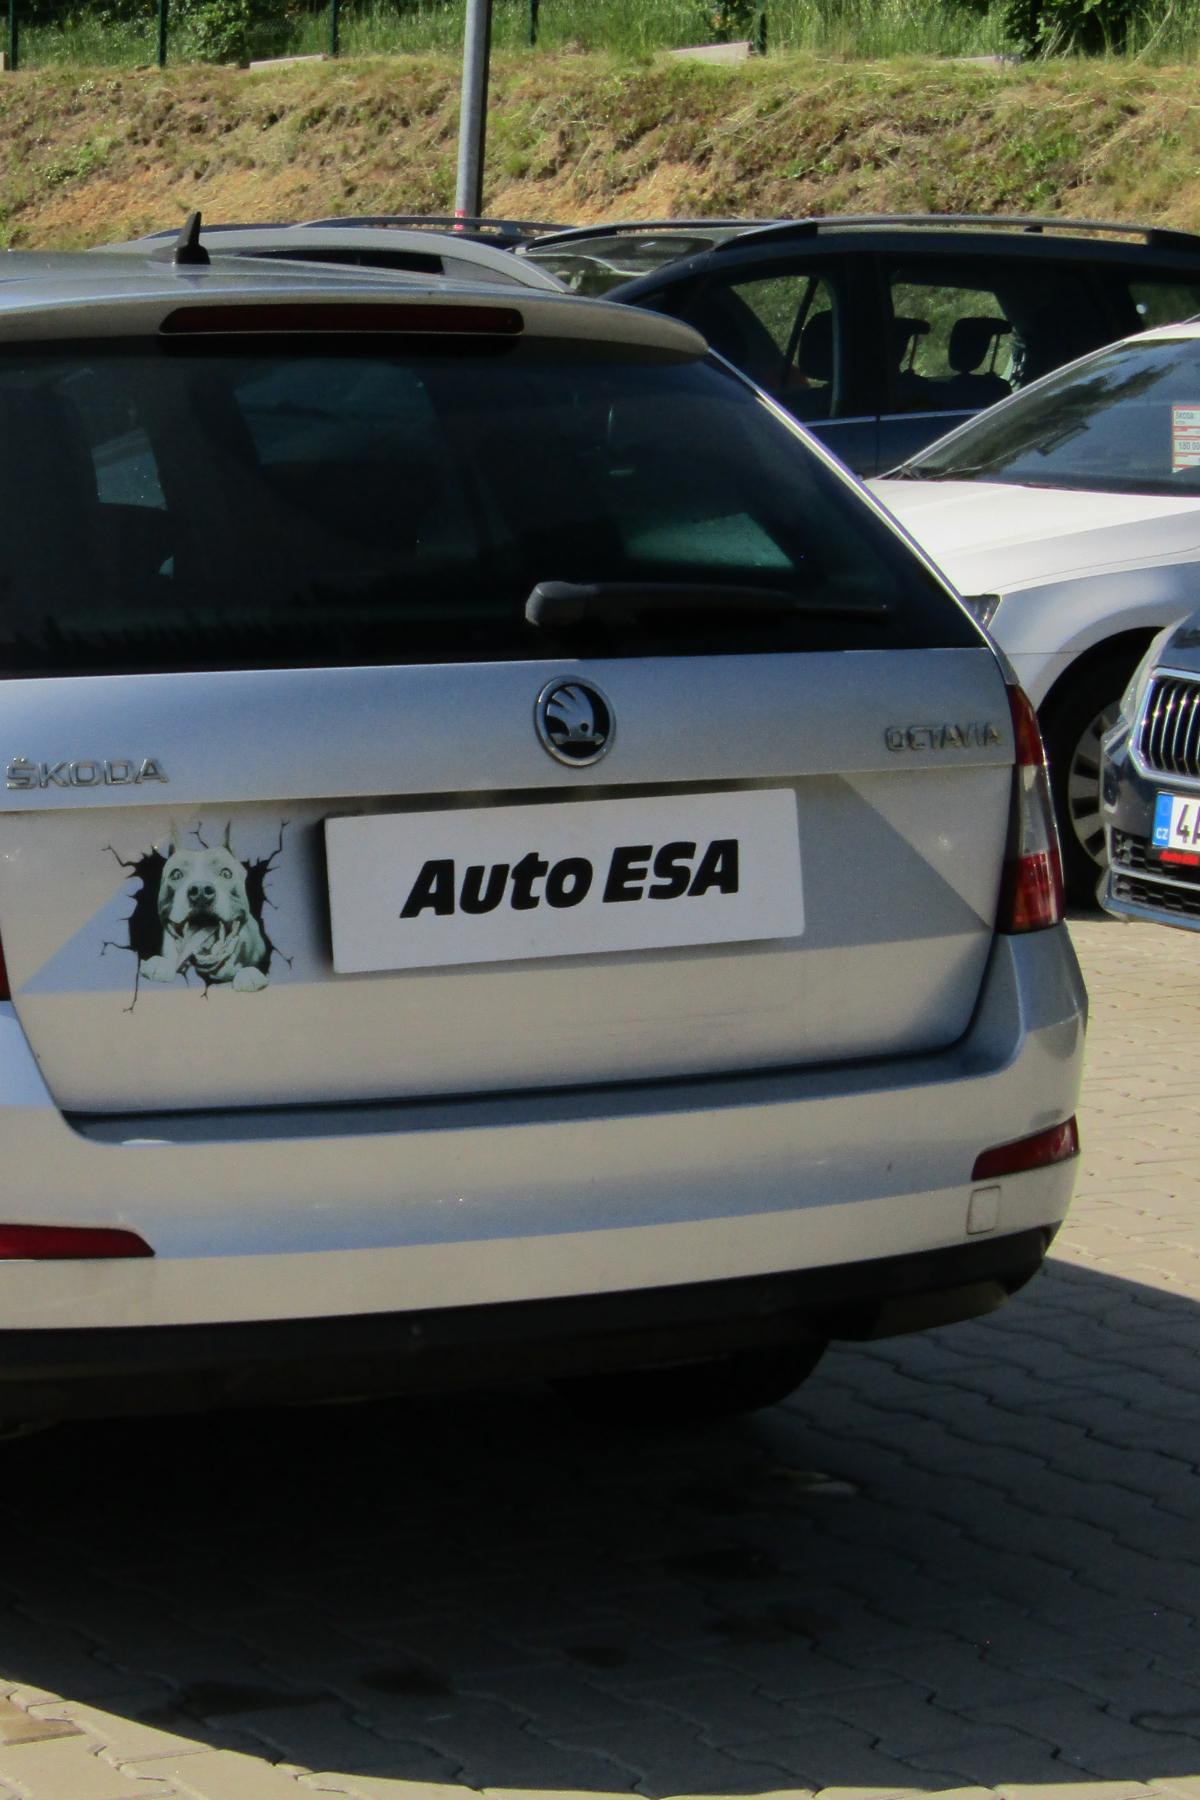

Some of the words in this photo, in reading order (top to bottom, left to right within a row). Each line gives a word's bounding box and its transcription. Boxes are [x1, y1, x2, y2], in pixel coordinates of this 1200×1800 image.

[885, 720, 1003, 752] OCTAVIA
[1155, 827, 1169, 841] CZ
[400, 852, 593, 918] Auto
[602, 839, 739, 903] ESA
